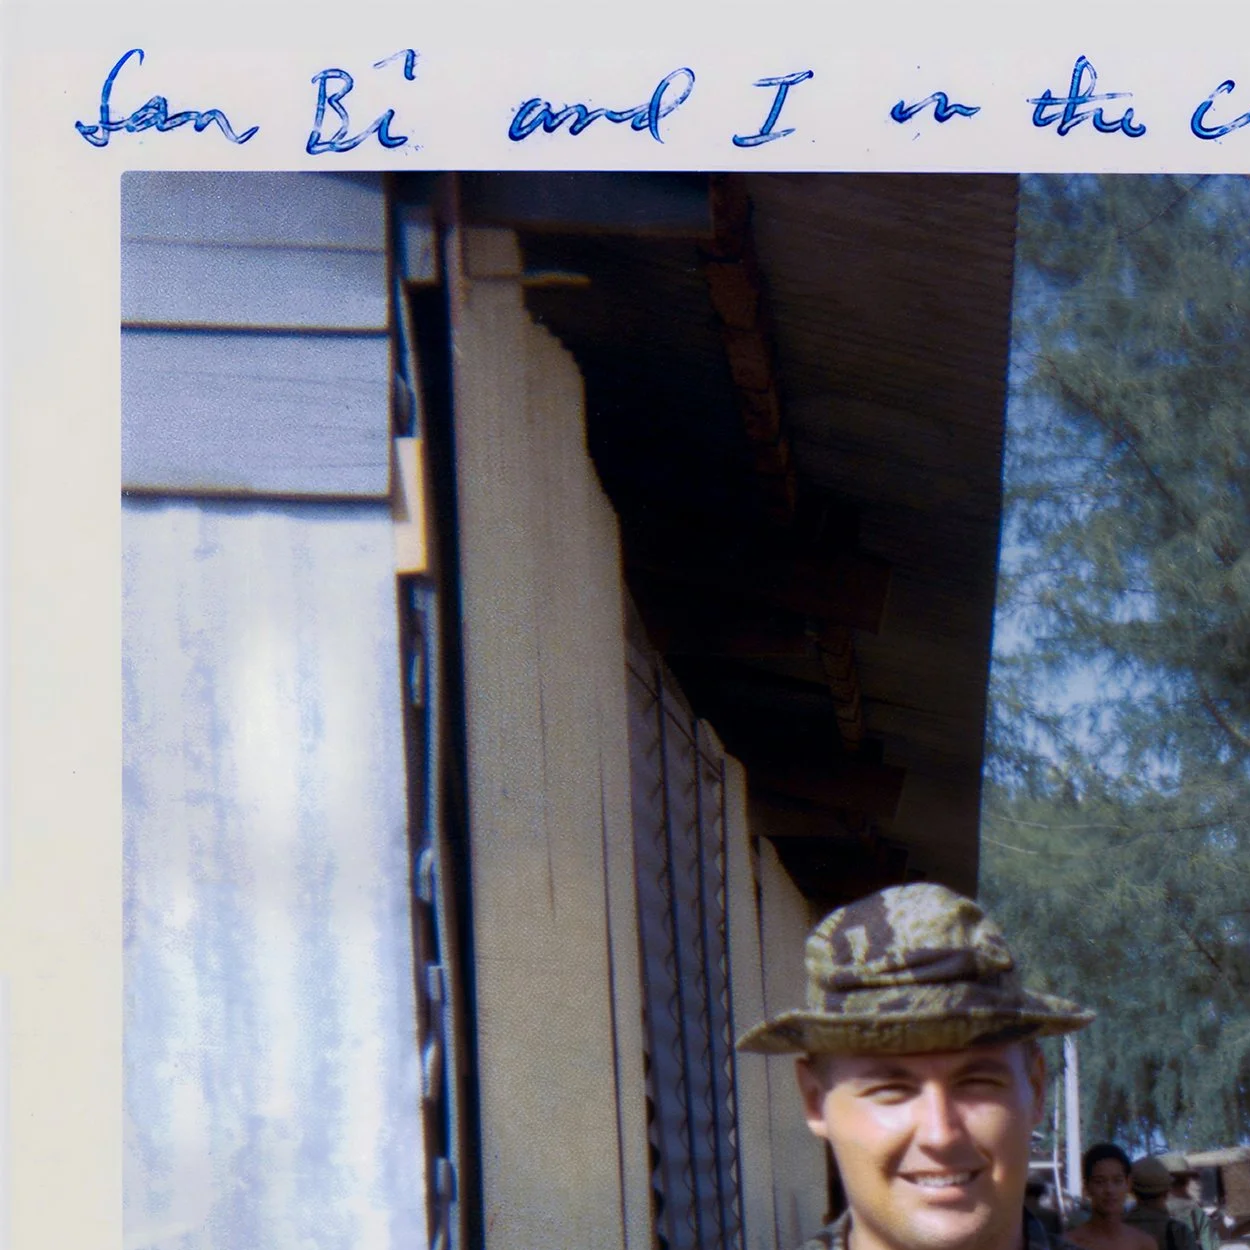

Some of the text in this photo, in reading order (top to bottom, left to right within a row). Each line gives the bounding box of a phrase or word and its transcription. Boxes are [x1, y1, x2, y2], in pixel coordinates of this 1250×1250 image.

[507, 66, 697, 146] and
[731, 69, 814, 149] I
[888, 91, 982, 124] in
[1026, 54, 1148, 137] the
